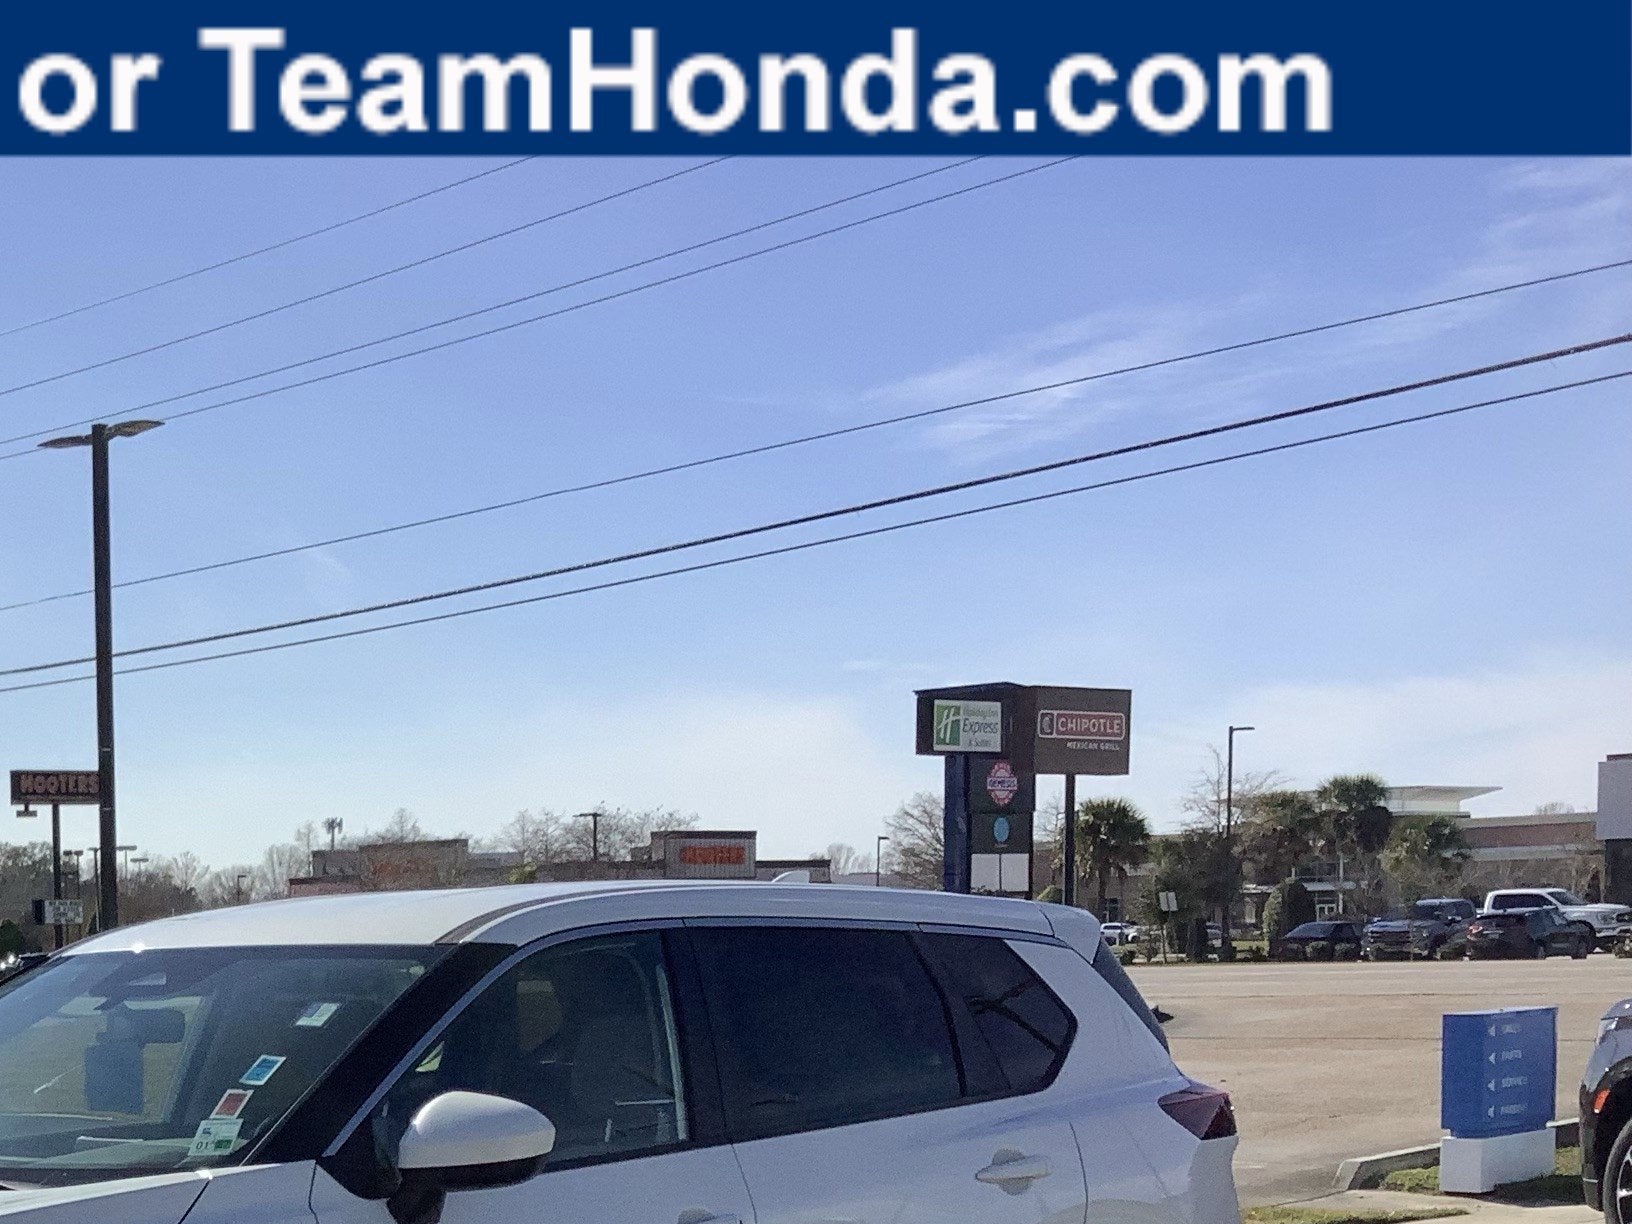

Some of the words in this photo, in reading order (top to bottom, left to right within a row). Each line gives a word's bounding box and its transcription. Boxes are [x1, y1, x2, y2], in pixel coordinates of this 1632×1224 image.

[962, 718, 999, 735] Express
[1057, 717, 1121, 733] CHIPOTLE
[1066, 741, 1099, 750] MEXICAN
